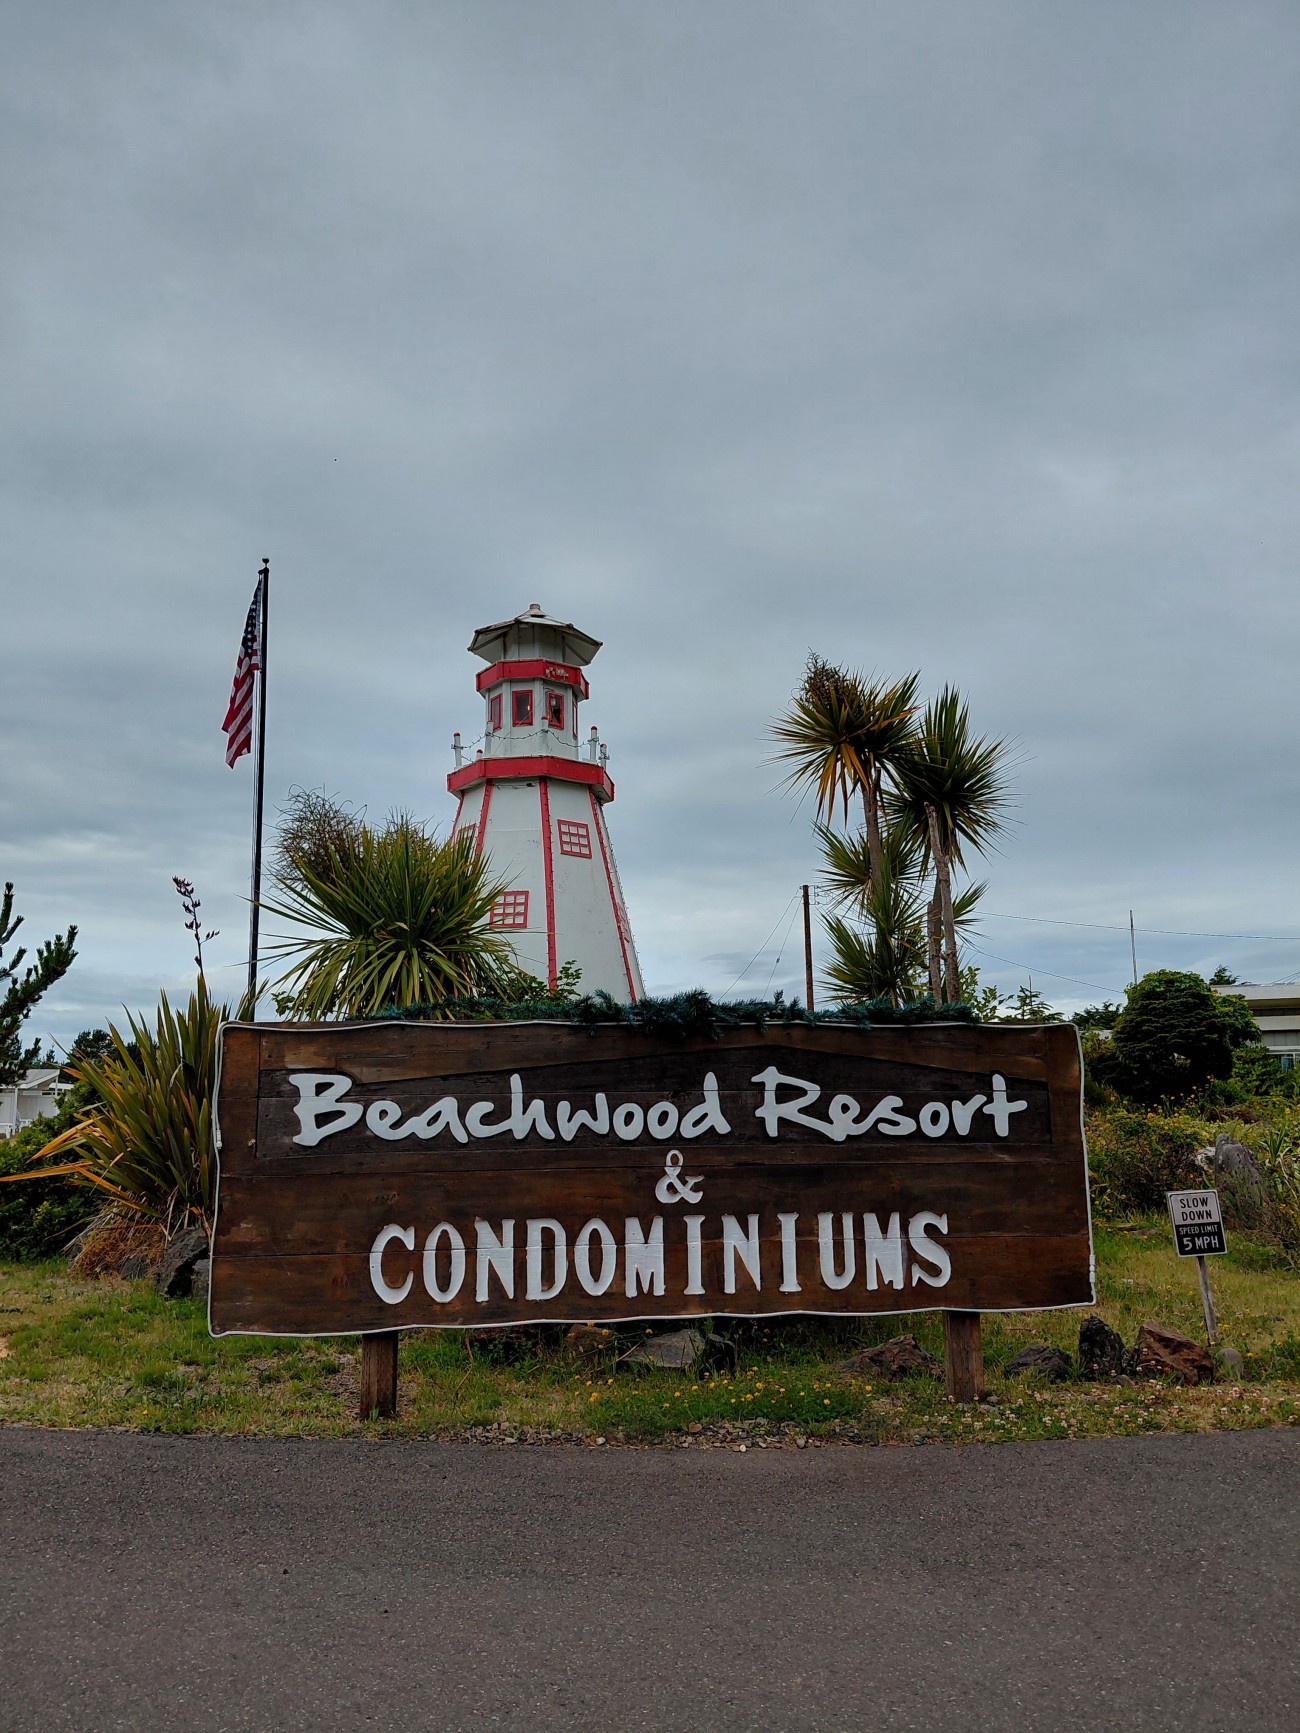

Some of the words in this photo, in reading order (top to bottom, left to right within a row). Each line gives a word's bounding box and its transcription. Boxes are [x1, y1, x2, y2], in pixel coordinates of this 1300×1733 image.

[289, 1072, 732, 1146] Beachwood
[751, 1066, 1028, 1142] Resort
[655, 1149, 704, 1204] &
[1180, 1197, 1208, 1208] SLOW
[1181, 1210, 1212, 1221] DOWN
[1179, 1226, 1199, 1234] SPEED
[1200, 1225, 1218, 1233] LIMIT
[1182, 1237, 1193, 1251] 5
[1195, 1235, 1219, 1250] MPH
[369, 1211, 952, 1304] CONDOMINIUMS
